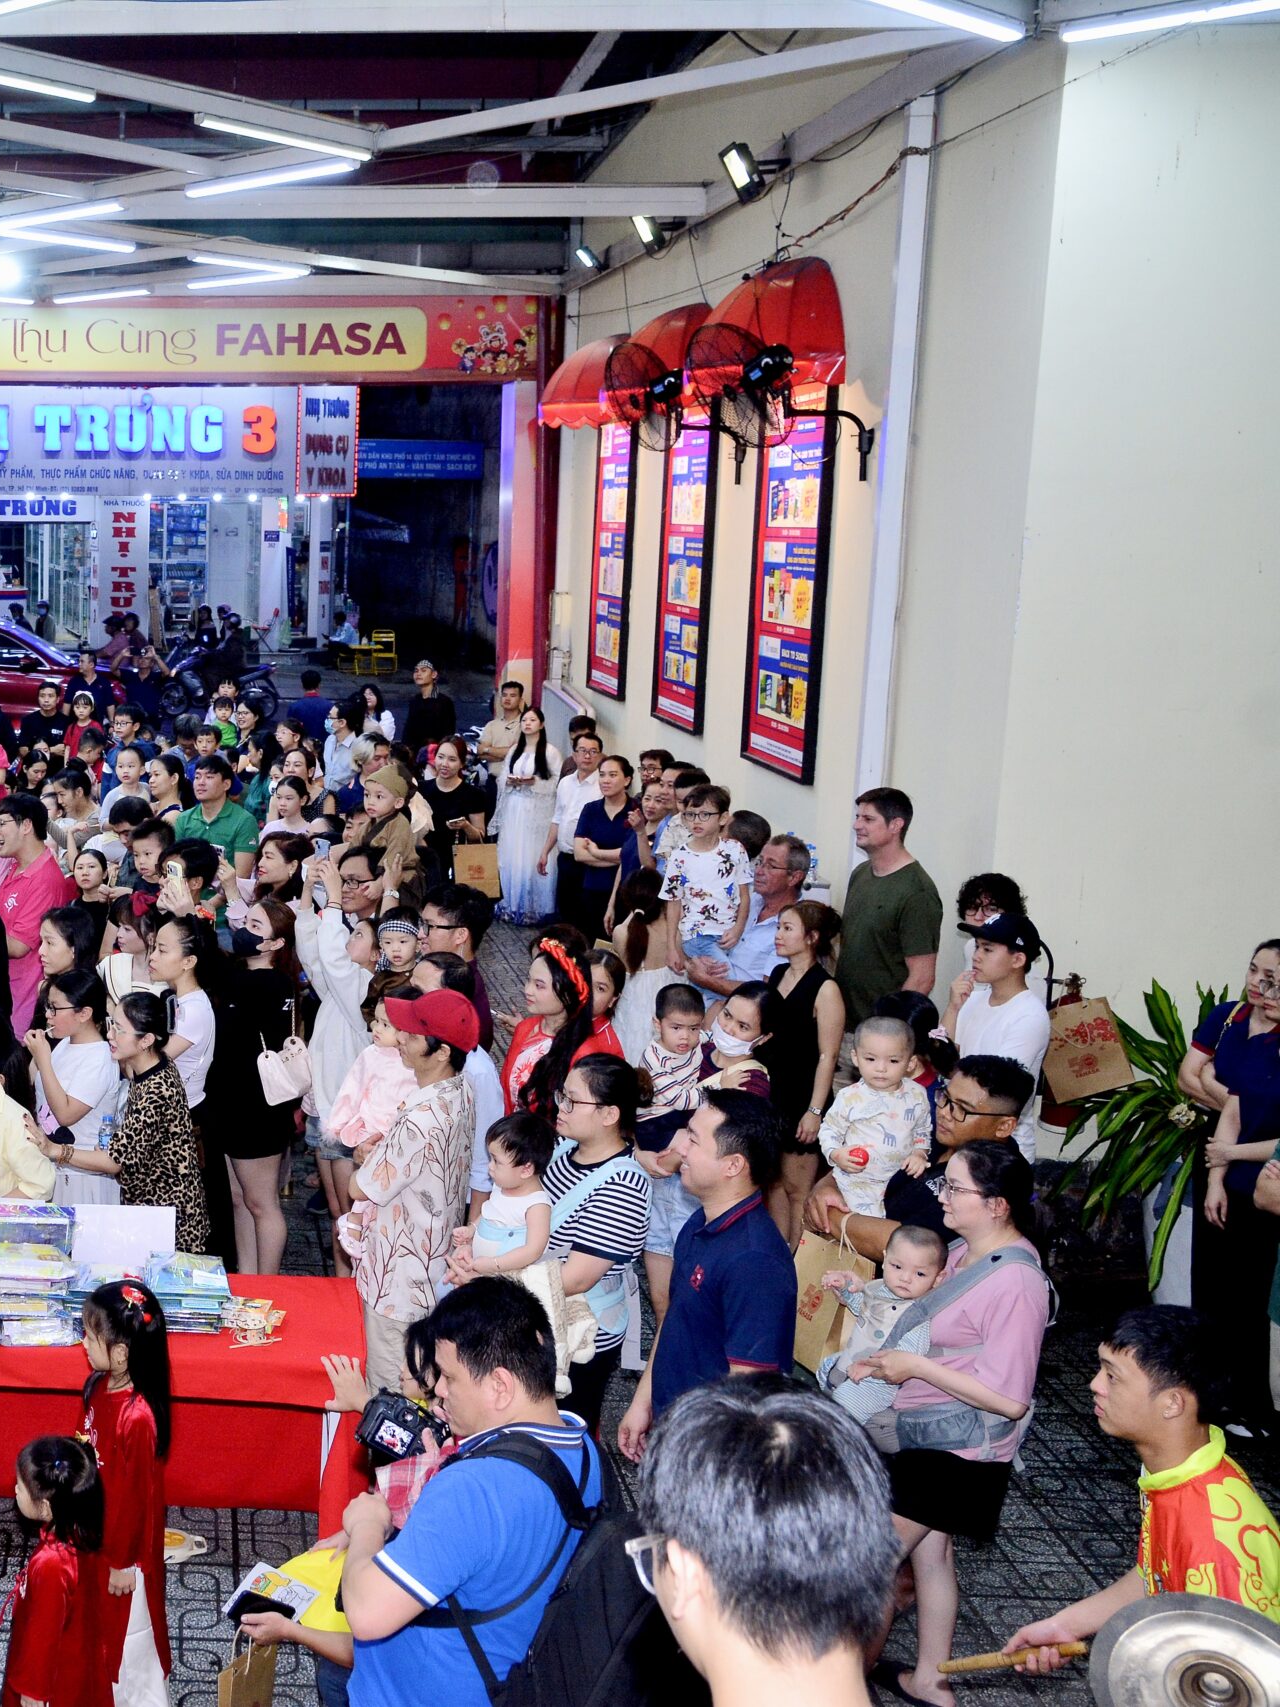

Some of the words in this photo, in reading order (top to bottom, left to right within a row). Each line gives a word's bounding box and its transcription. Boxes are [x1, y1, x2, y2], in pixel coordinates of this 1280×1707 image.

[1, 317, 68, 364] Thu
[85, 317, 198, 366] Cùng
[215, 321, 408, 357] FAHASA
[305, 397, 320, 423] NHỊ
[34, 393, 224, 454] TRƯNG
[242, 404, 277, 455] 3
[10, 464, 36, 479] PHẨM,
[41, 467, 61, 481] THỰC
[64, 464, 87, 479] PHẨM
[89, 465, 111, 479] CHỨC
[235, 469, 254, 481] DINH
[306, 467, 315, 489] Y
[317, 467, 347, 489] KHOA
